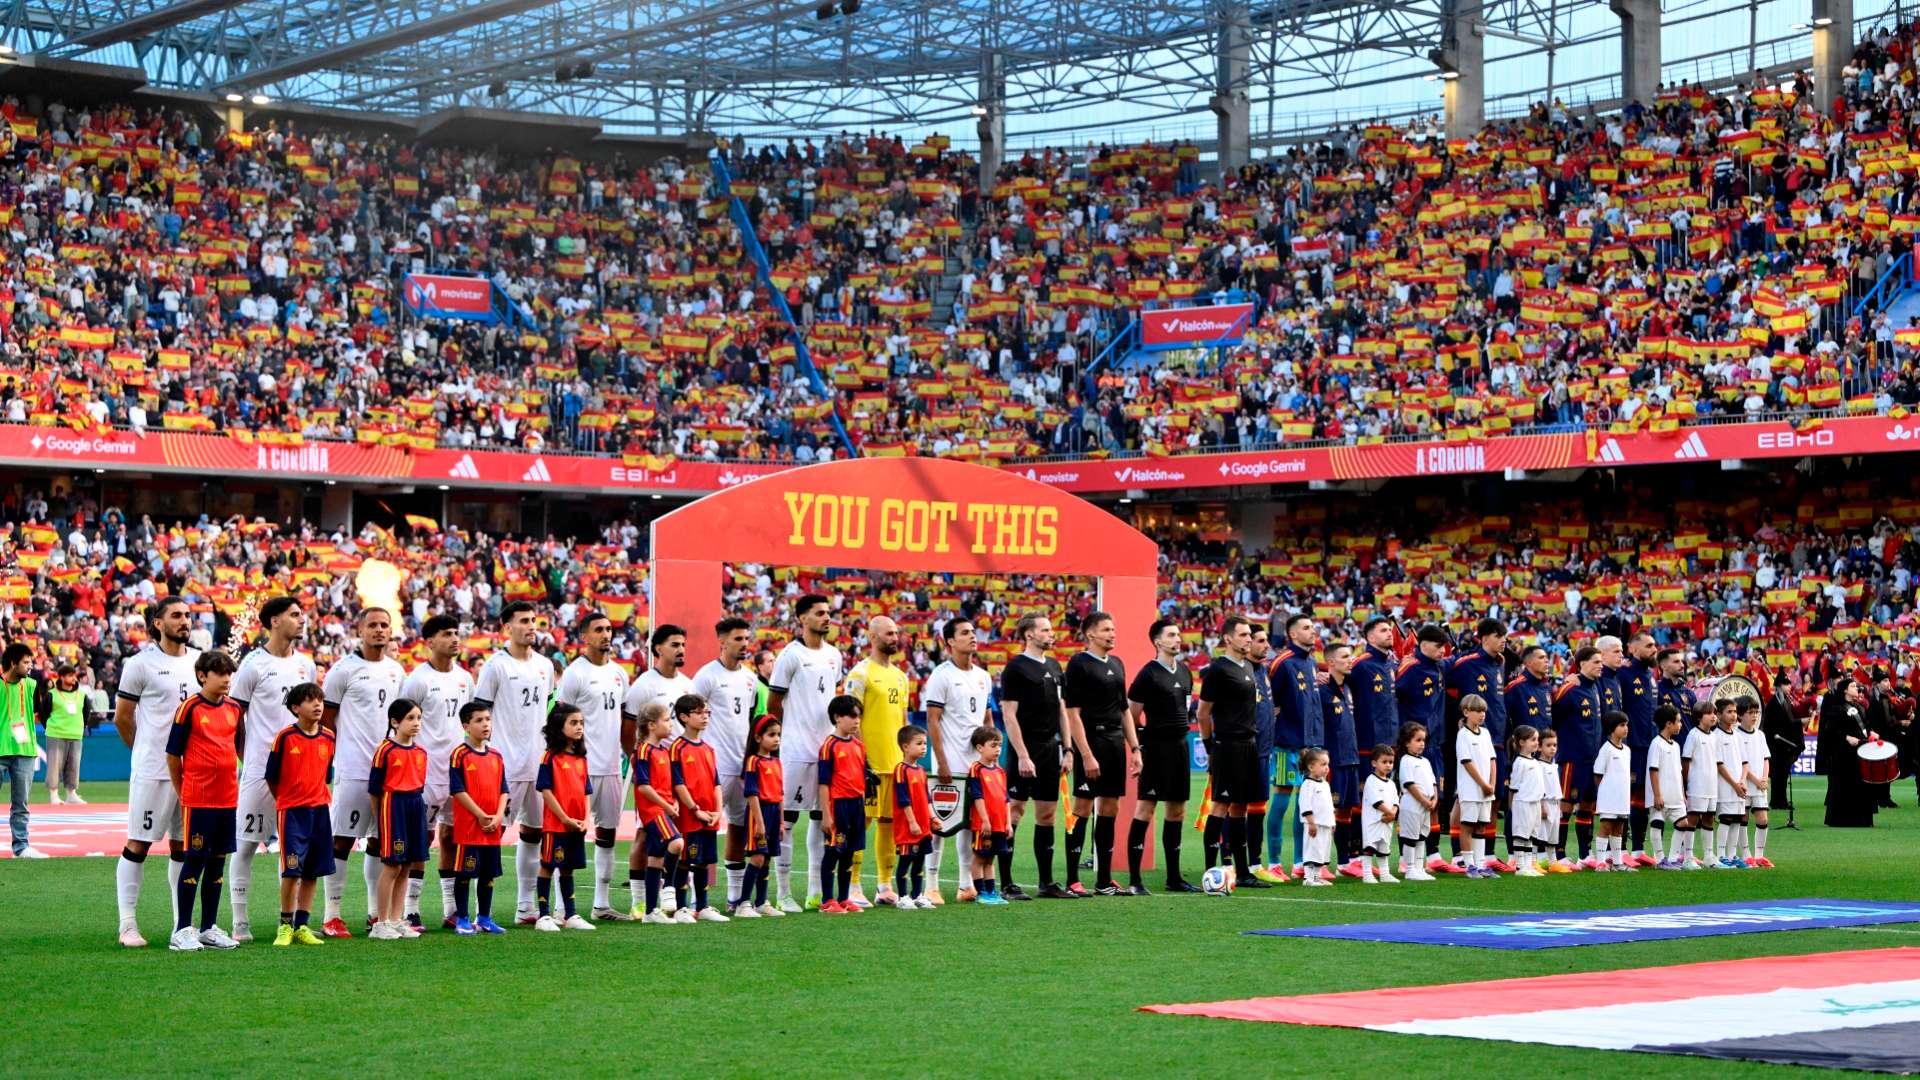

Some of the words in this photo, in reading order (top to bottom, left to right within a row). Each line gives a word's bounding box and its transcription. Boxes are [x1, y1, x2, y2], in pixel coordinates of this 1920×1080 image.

[440, 288, 483, 300] movistar
[1179, 319, 1215, 333] Halcón
[45, 436, 91, 454] Google
[93, 437, 136, 454] Gemini
[258, 444, 267, 470] A
[271, 442, 329, 472] CORUÑA
[1416, 448, 1425, 474] A
[1428, 442, 1485, 472] CORUÑA
[1039, 472, 1079, 482] movistar
[1132, 468, 1168, 481] Halcón
[1231, 461, 1269, 477] Google
[1269, 458, 1306, 473] Gemini
[784, 491, 870, 549] YOU
[879, 498, 958, 553] GOT
[966, 502, 1059, 556] THIS
[180, 683, 188, 702] 5
[818, 676, 825, 694] 4
[281, 685, 294, 705] 2
[378, 689, 386, 708] 9
[522, 686, 540, 707] 24
[602, 691, 616, 710] 16
[887, 688, 899, 704] 22
[445, 698, 459, 717] 17
[734, 697, 741, 714] 3
[969, 697, 977, 713] 8
[794, 785, 803, 804] 4
[143, 810, 153, 830] 5
[244, 813, 264, 833] 21
[349, 809, 360, 829] 9
